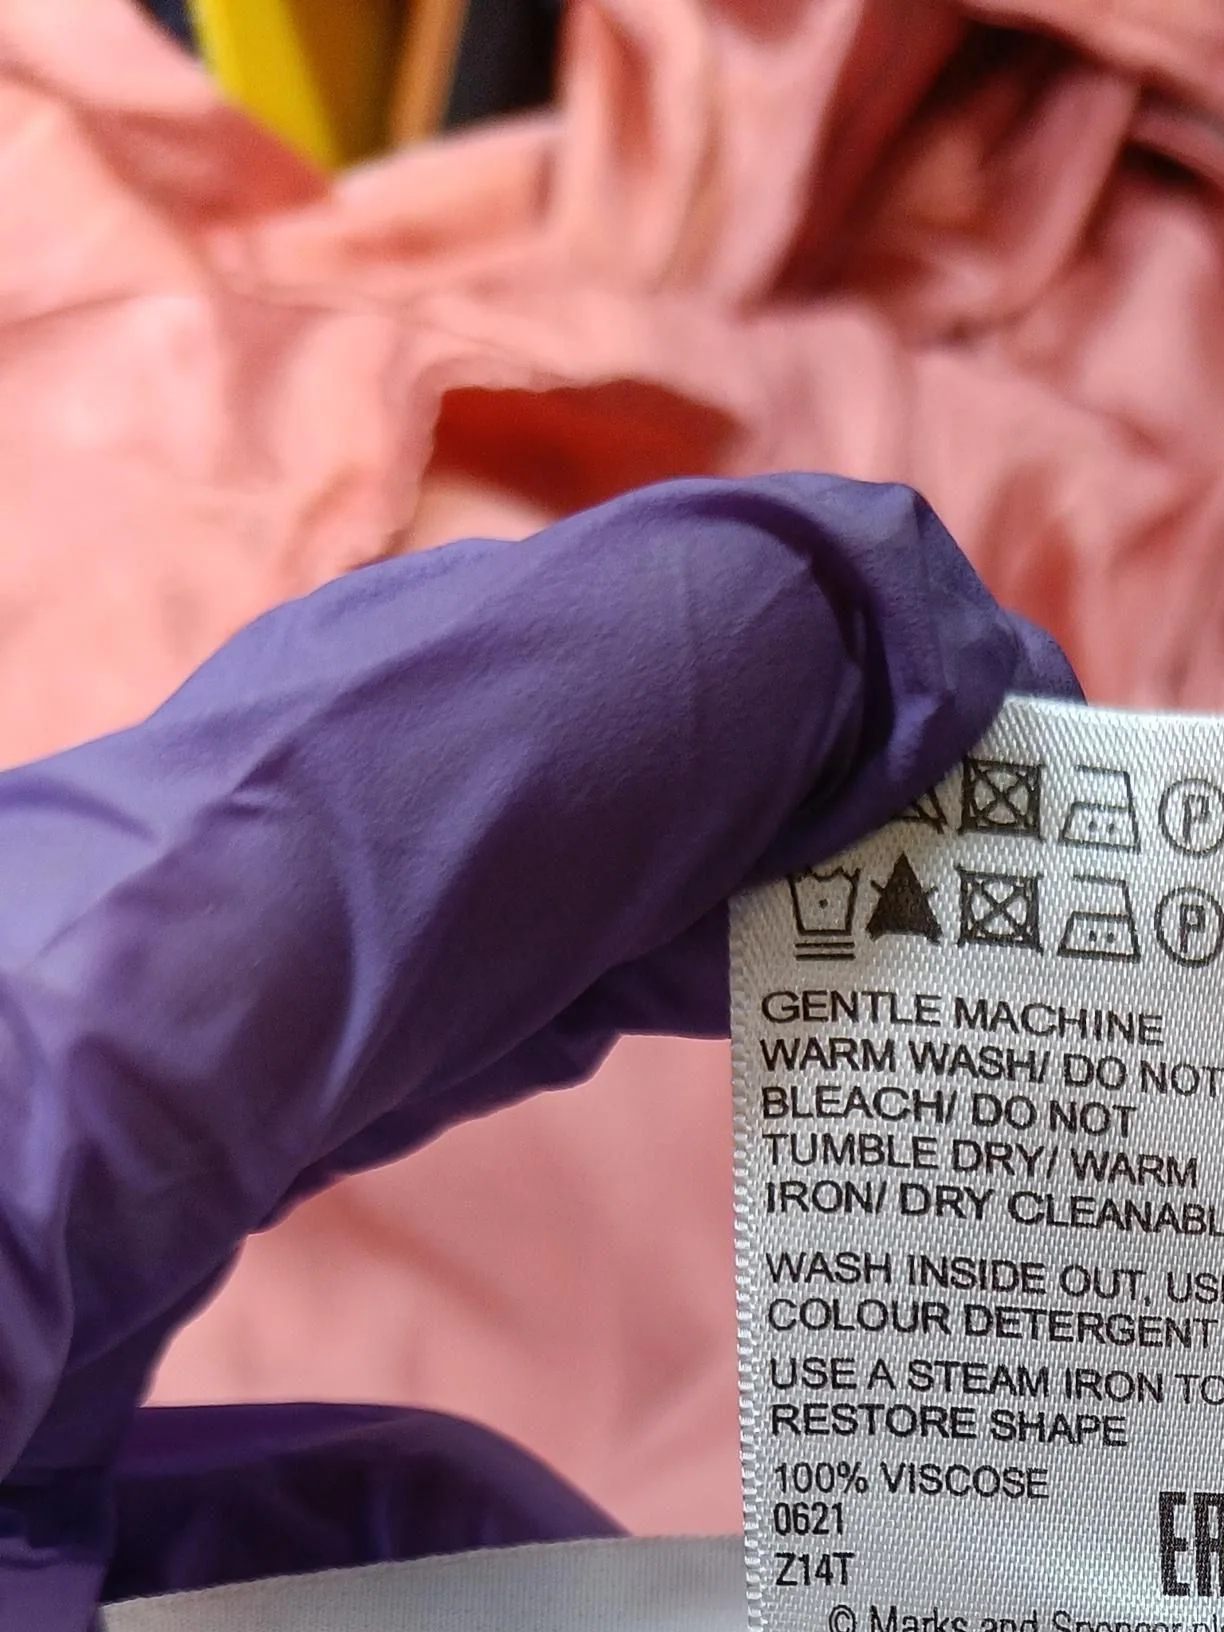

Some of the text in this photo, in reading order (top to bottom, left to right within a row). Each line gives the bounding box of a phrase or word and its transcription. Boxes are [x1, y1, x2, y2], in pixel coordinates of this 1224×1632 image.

[762, 992, 1163, 1045] GENTLE MACHINE
[761, 1039, 1224, 1097] WARM WASH/ DO NOT
[763, 1087, 1137, 1137] BLEACH/ DO NOT
[763, 1134, 1199, 1187] TUMBLE DRY/ WARM
[766, 1182, 886, 1215] IRON/
[901, 1184, 995, 1218] DRY
[767, 1252, 892, 1285] WASH
[908, 1255, 1046, 1295] INSIDE
[1060, 1264, 1151, 1306] OUT,
[768, 1299, 1218, 1350] COLOUR DETERGENT
[770, 1358, 857, 1390] USE
[869, 1360, 896, 1392] A
[907, 1361, 1050, 1398] STEAM
[1065, 1367, 1164, 1405] IRON
[771, 1404, 1128, 1447] RESTORE SHAPE
[774, 1462, 1050, 1499] 100% VISCOSE
[774, 1502, 845, 1536] 0621
[775, 1552, 856, 1586] Z14T
